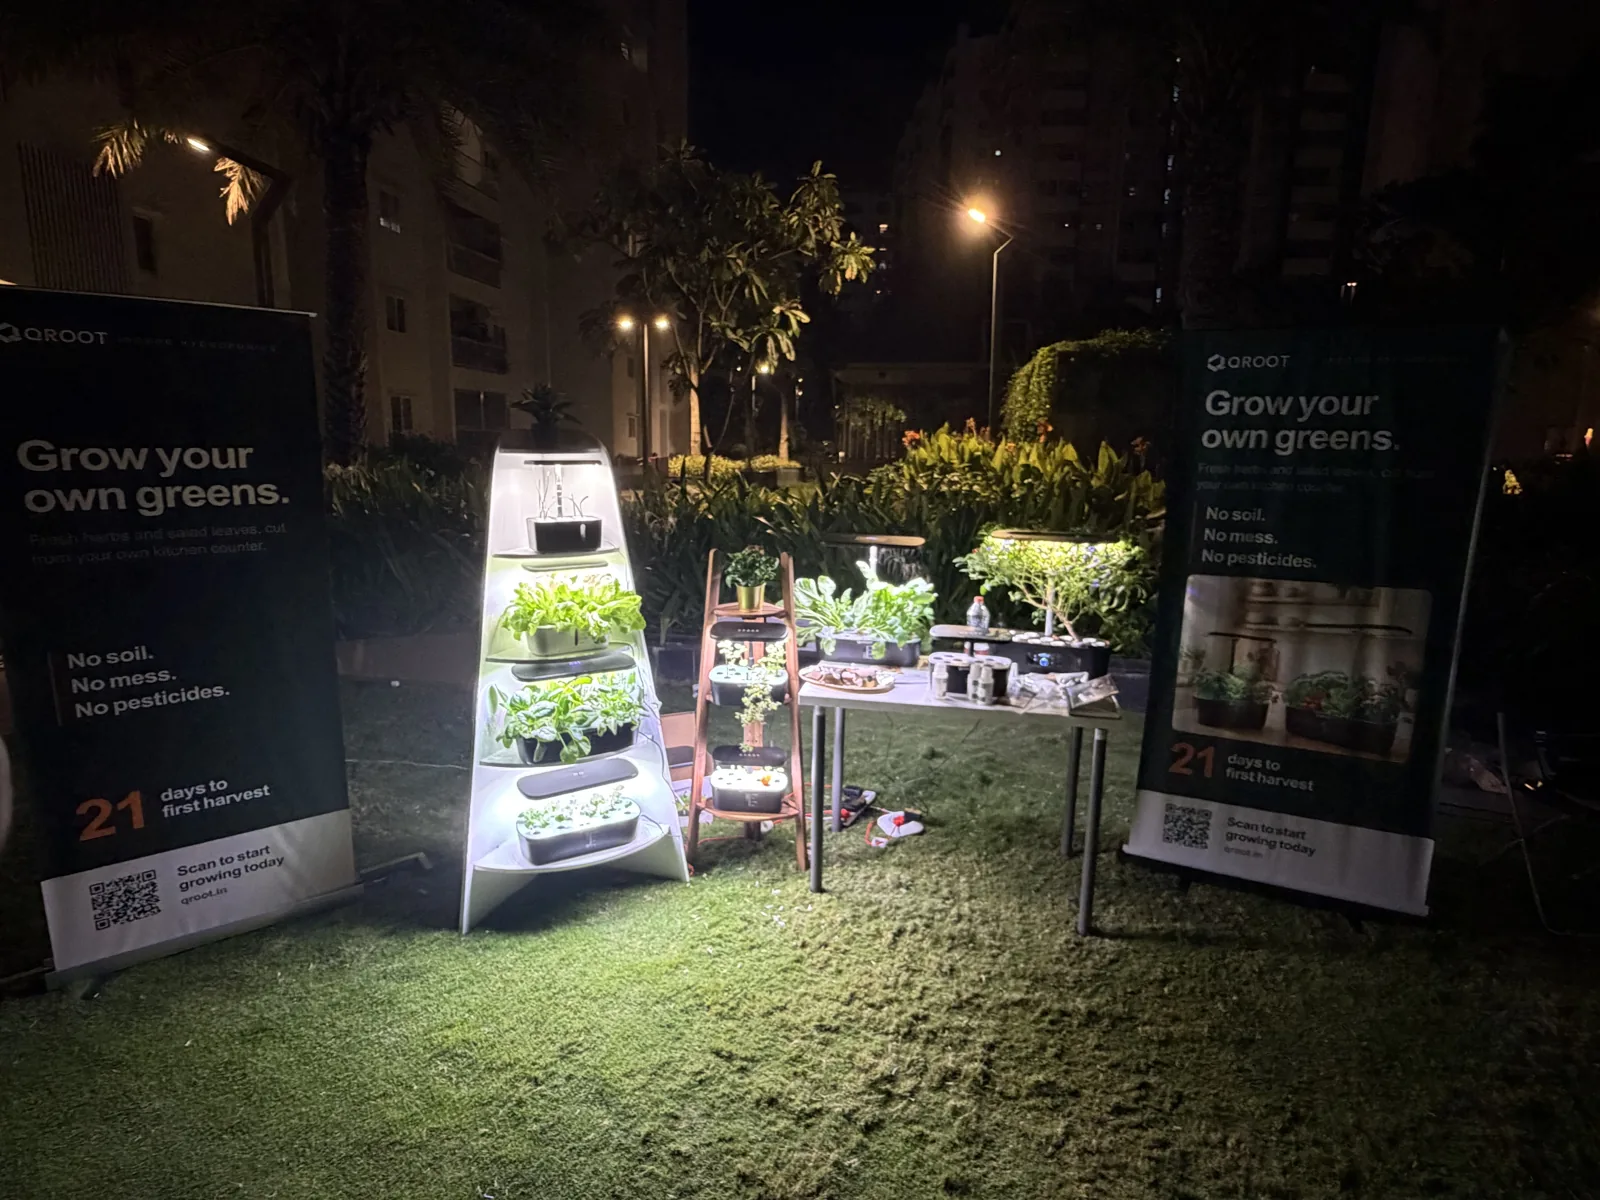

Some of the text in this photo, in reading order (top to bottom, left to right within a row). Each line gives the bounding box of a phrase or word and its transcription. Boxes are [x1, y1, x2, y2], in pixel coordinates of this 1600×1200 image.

[24, 327, 108, 345] QROOT
[1228, 355, 1291, 368] QROOT
[1205, 389, 1380, 423] Grow your
[1201, 428, 1400, 456] own greens.
[16, 439, 254, 478] Grow your
[24, 483, 290, 516] own greens.
[1206, 506, 1266, 521] No soil.
[1204, 527, 1278, 544] No mess.
[1202, 549, 1317, 568] No pesticides.
[66, 645, 154, 669] No soil.
[71, 669, 177, 694] No mess.
[75, 684, 230, 718] No pesticides.
[1168, 742, 1215, 778] 21
[1227, 753, 1281, 771] days to
[160, 779, 228, 804] days to
[1225, 767, 1314, 792] first harvest
[162, 784, 271, 818] first harvest
[75, 790, 145, 842] 21
[1227, 817, 1306, 840] Scan to start
[1226, 832, 1316, 857] growing today
[177, 845, 271, 877] Scan to start
[179, 855, 285, 892] growing today
[180, 886, 228, 905] qroot.in
